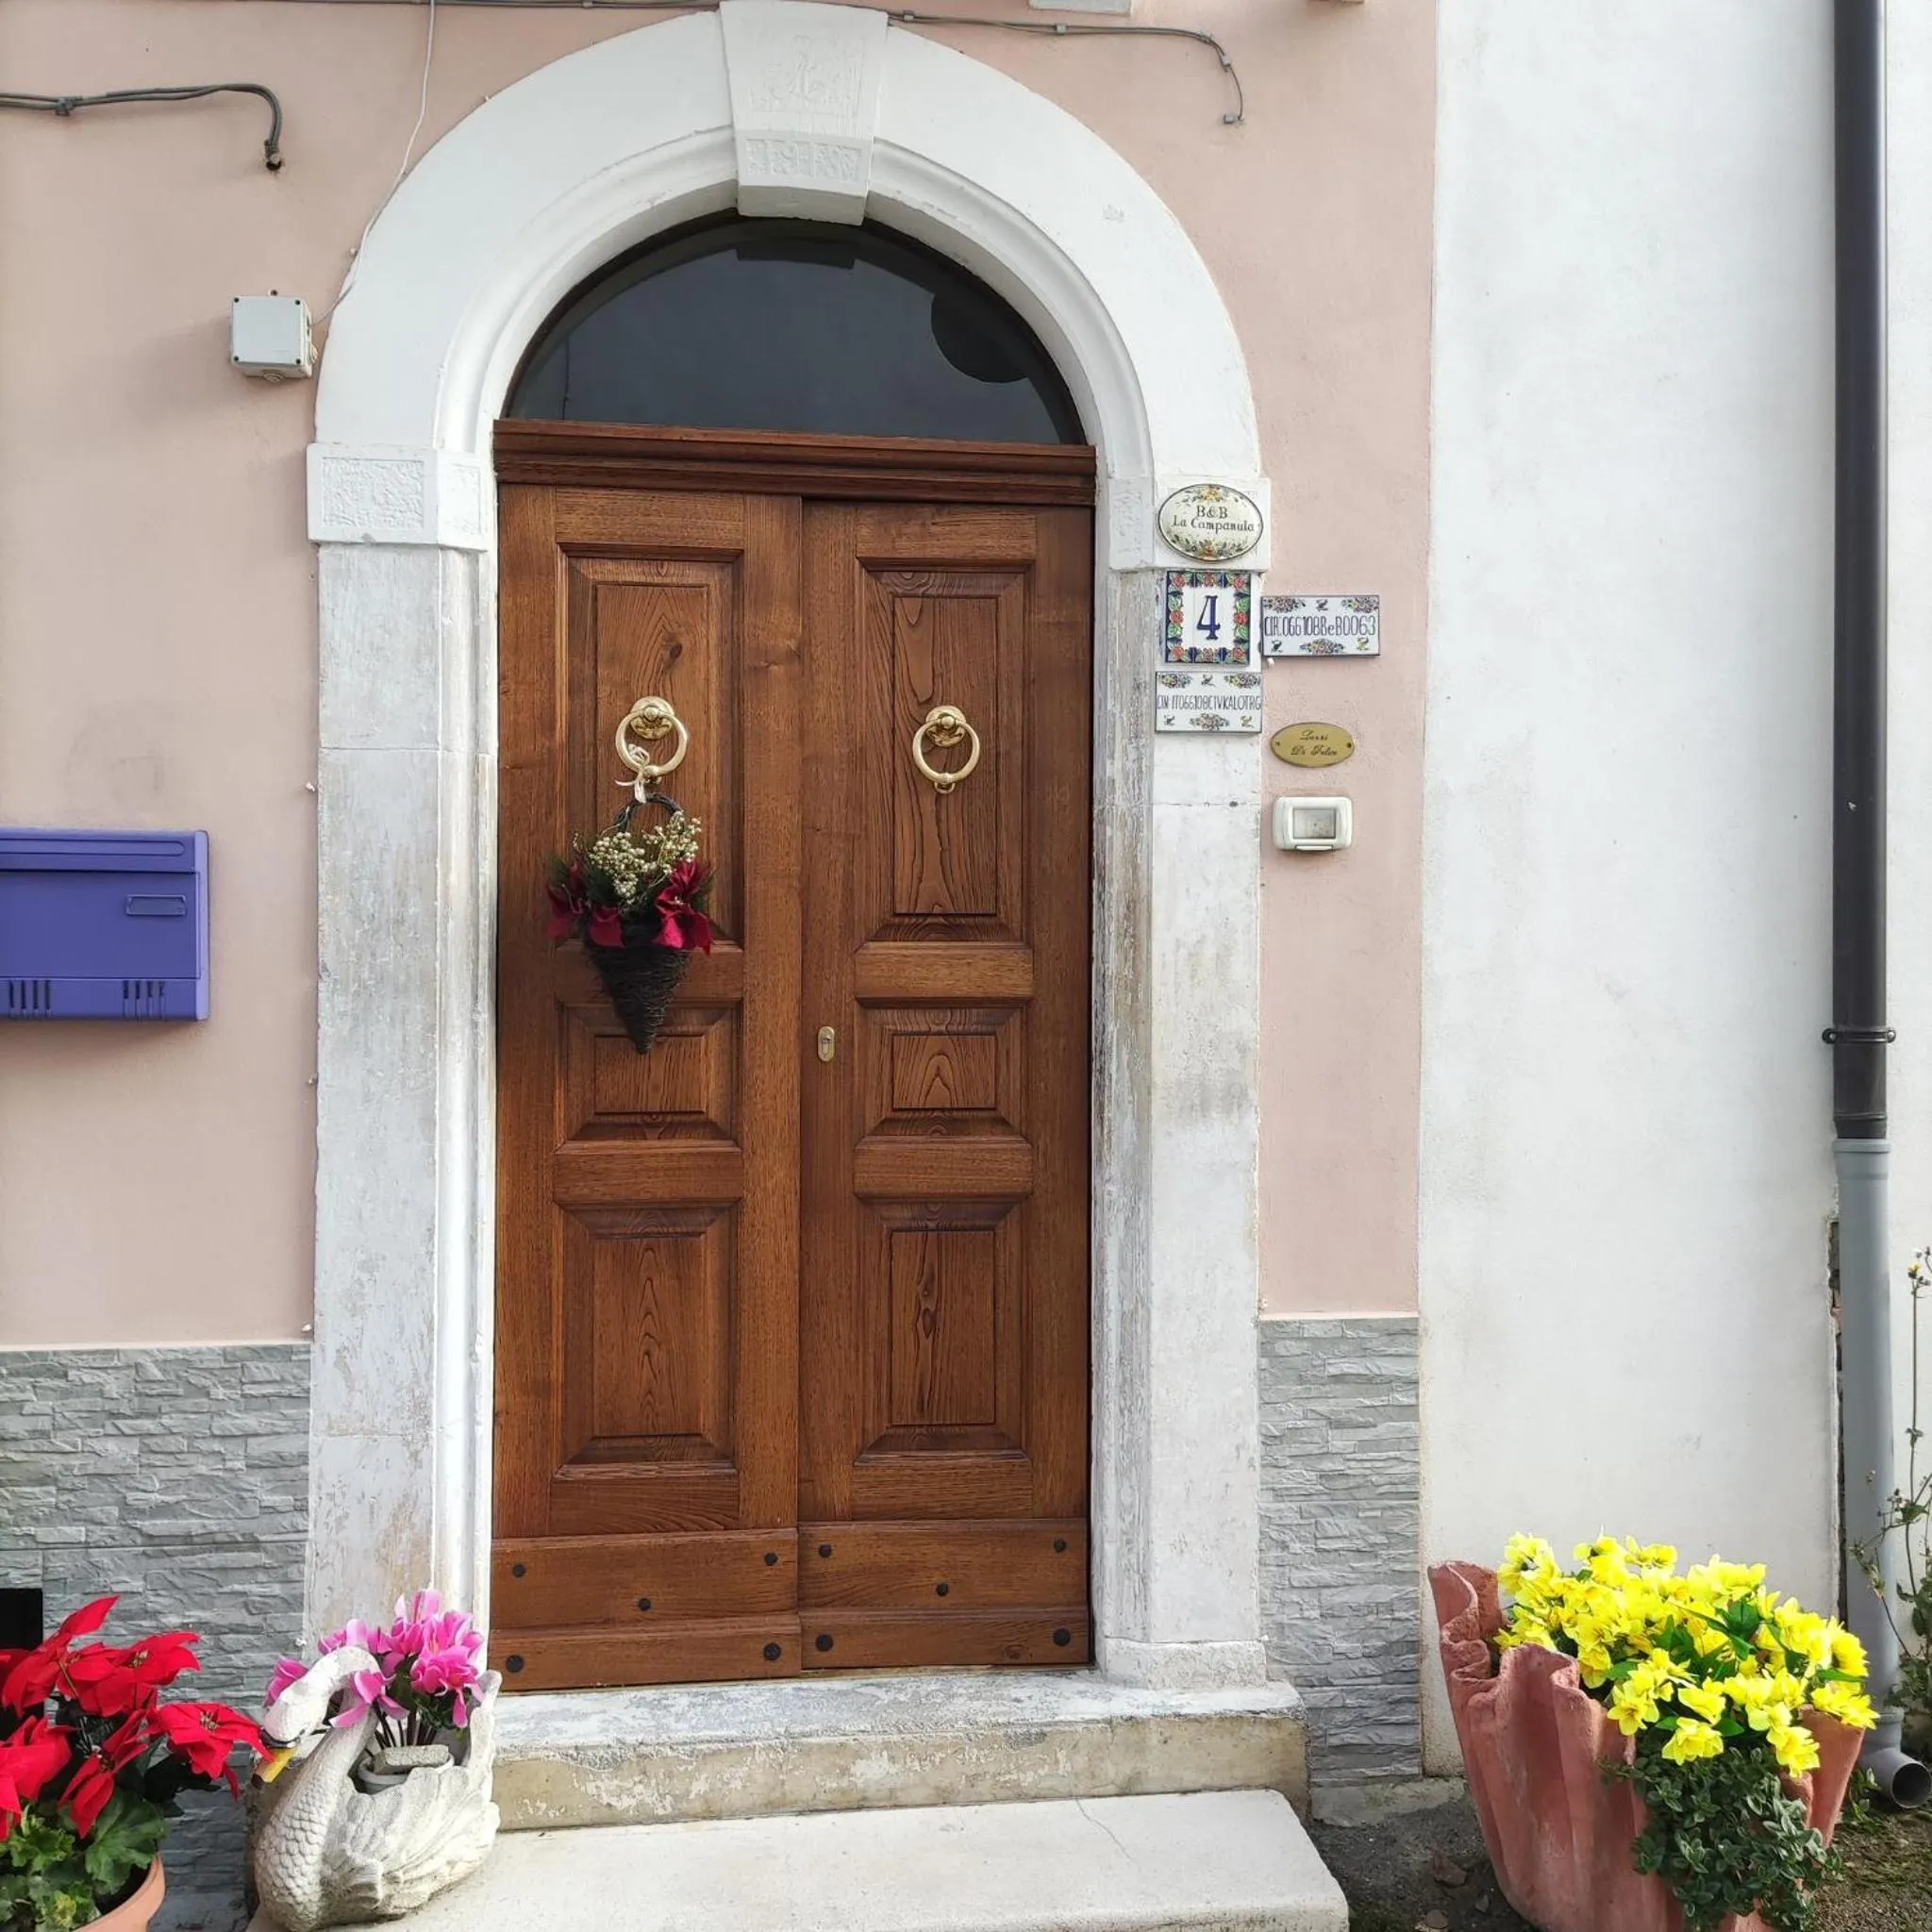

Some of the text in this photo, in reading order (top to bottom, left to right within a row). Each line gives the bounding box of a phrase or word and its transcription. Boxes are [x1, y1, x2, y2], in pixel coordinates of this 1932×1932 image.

[1195, 505, 1228, 519] B&B
[1172, 514, 1255, 534] La Campanula
[1196, 595, 1221, 641] 4
